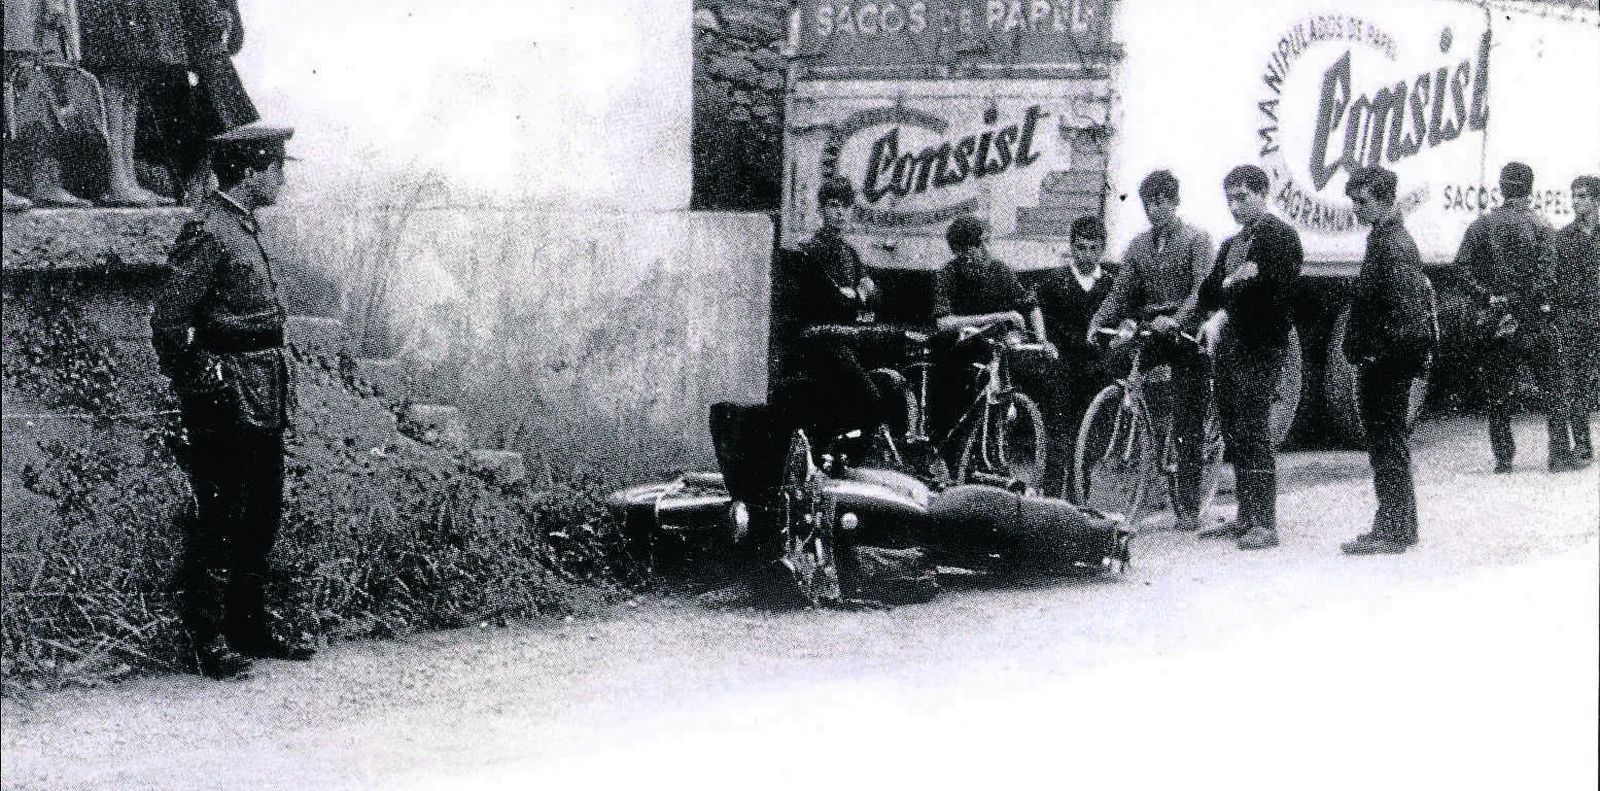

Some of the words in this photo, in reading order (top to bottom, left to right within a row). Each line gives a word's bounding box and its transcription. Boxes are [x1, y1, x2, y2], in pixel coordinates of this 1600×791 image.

[815, 1, 927, 35] SACOS
[1310, 28, 1492, 191] Consist
[863, 104, 1051, 203] Consist
[1444, 185, 1500, 211] SACOS
